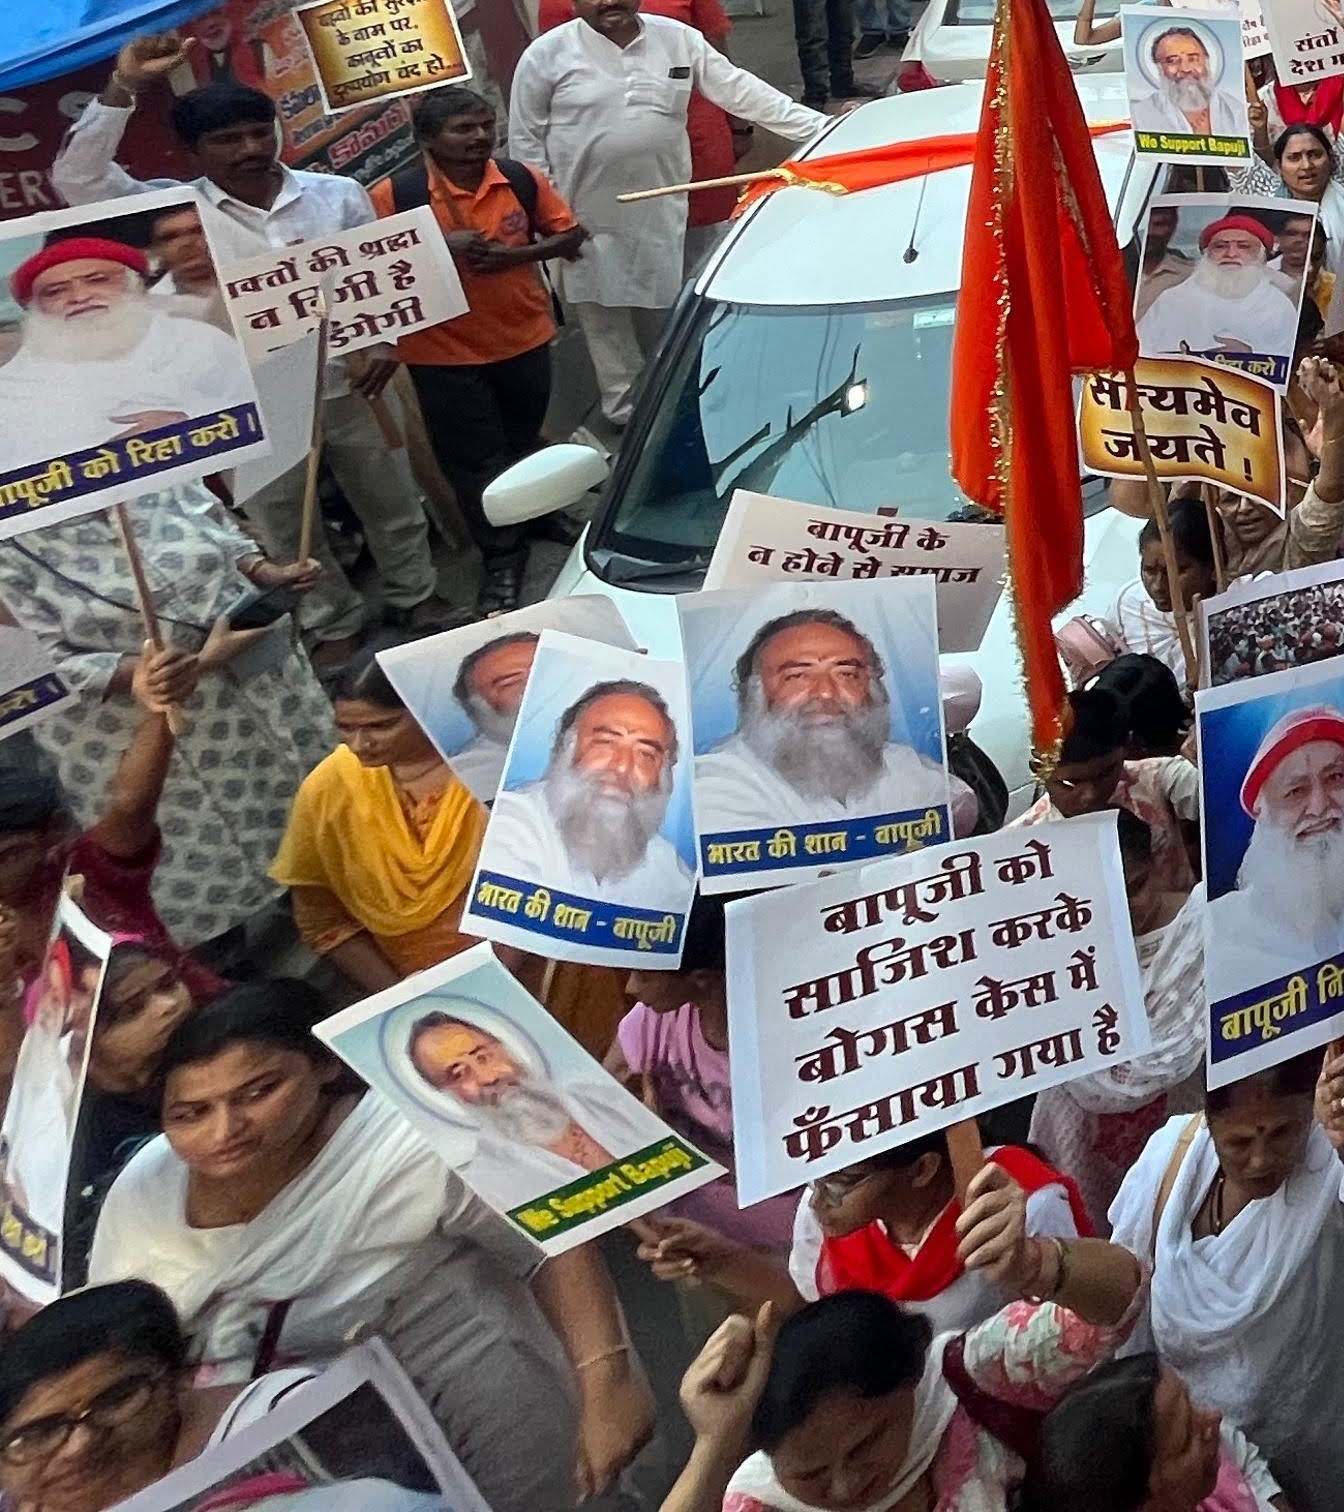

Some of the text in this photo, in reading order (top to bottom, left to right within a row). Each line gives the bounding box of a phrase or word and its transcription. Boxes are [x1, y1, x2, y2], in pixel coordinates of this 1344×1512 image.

[1139, 135, 1247, 155] We Support Bapuji
[1088, 372, 1263, 437] सत्यमेव
[1101, 423, 1227, 469] जयते
[807, 517, 950, 552] बापूजी के
[476, 879, 678, 953] भारत की शान बापूजी
[820, 839, 1056, 936] बापूजी को
[782, 891, 1094, 1021] साजिश करके
[795, 945, 1101, 1085] बोगस केस में
[1220, 975, 1309, 1040] बापूजी
[782, 1002, 1121, 1163] फँसाया गया है
[549, 1171, 633, 1218] Support
[618, 1142, 693, 1185] Bapuji
